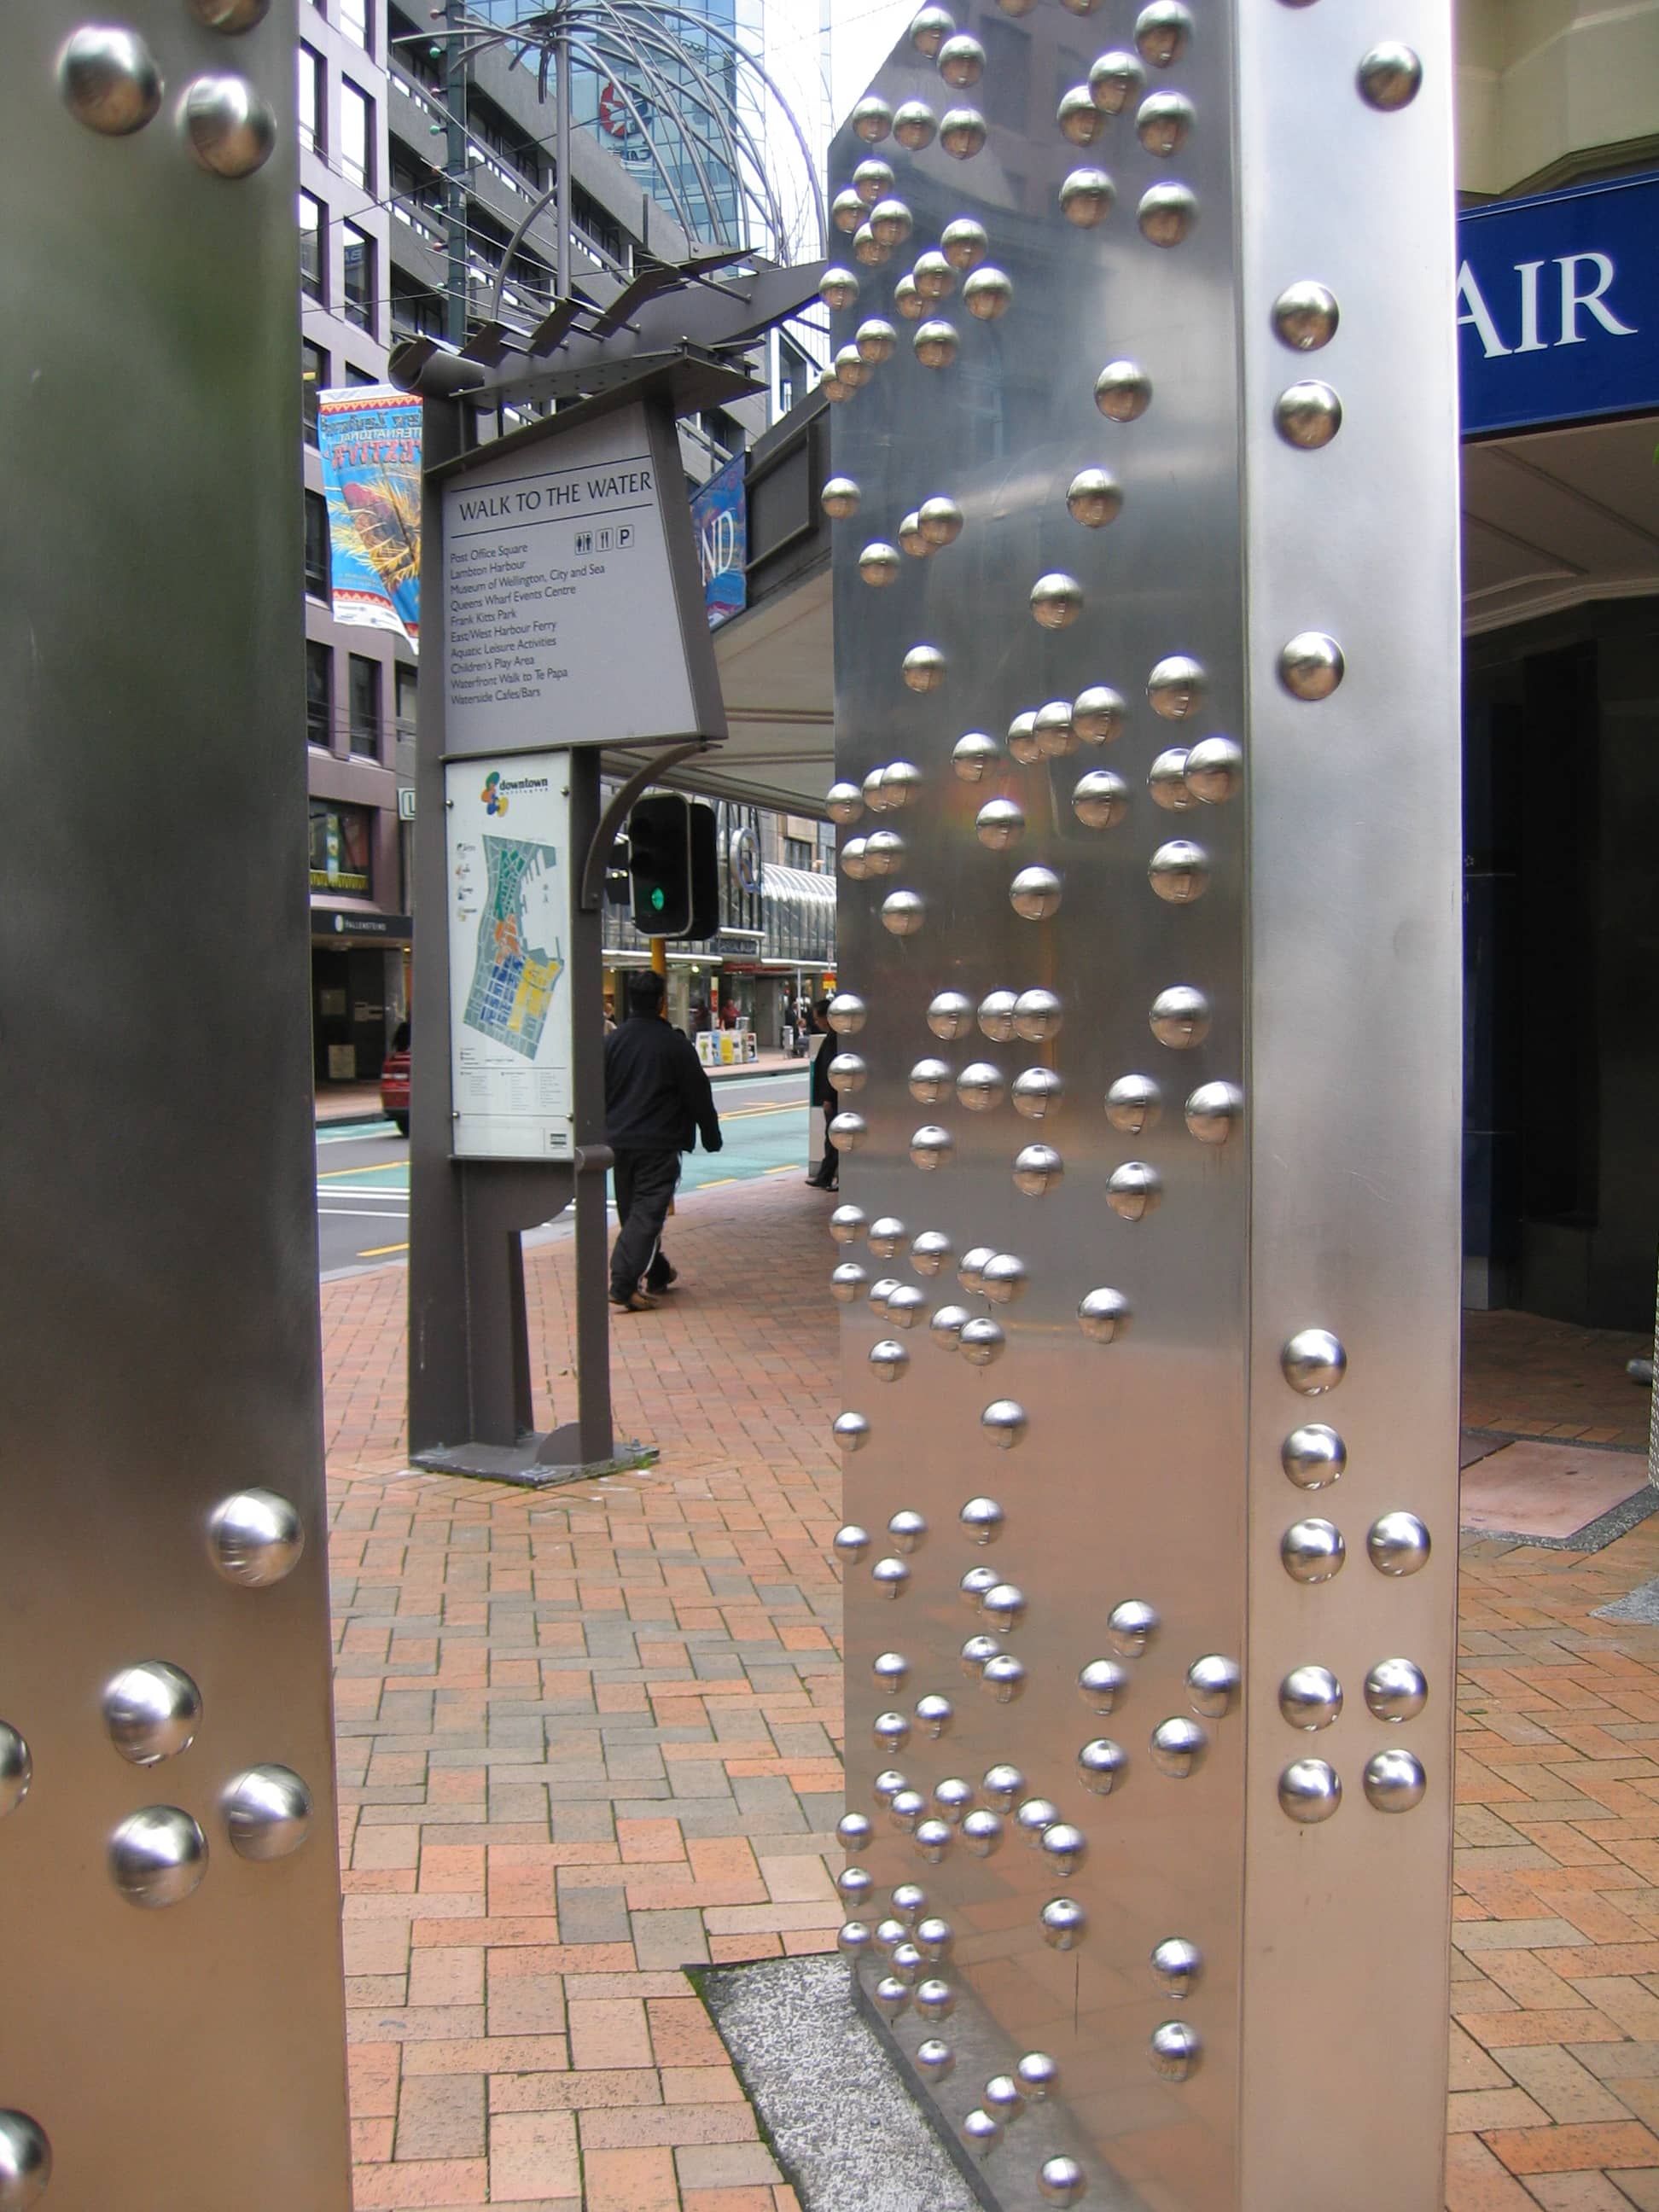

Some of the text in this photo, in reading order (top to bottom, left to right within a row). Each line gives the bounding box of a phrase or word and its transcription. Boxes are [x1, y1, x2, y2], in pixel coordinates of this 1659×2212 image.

[459, 471, 652, 521] WALK TO THE WATER
[450, 544, 528, 563] Post Office Square
[450, 561, 526, 579] Lambton Harbour
[450, 564, 605, 595] Museum of Wellington, City and Sea
[450, 585, 576, 612] Queens Wharf Events Centre
[450, 609, 517, 626] Frank Kitts Park
[494, 625, 531, 637] Harbour
[533, 621, 557, 633] Ferry
[450, 637, 556, 659] Aquatic Leisure Activities
[450, 655, 535, 674] Children's Play Area
[450, 667, 568, 690] Waterfront Walk to Te Papa
[450, 693, 492, 705] Waterside
[499, 777, 548, 790] downtown
